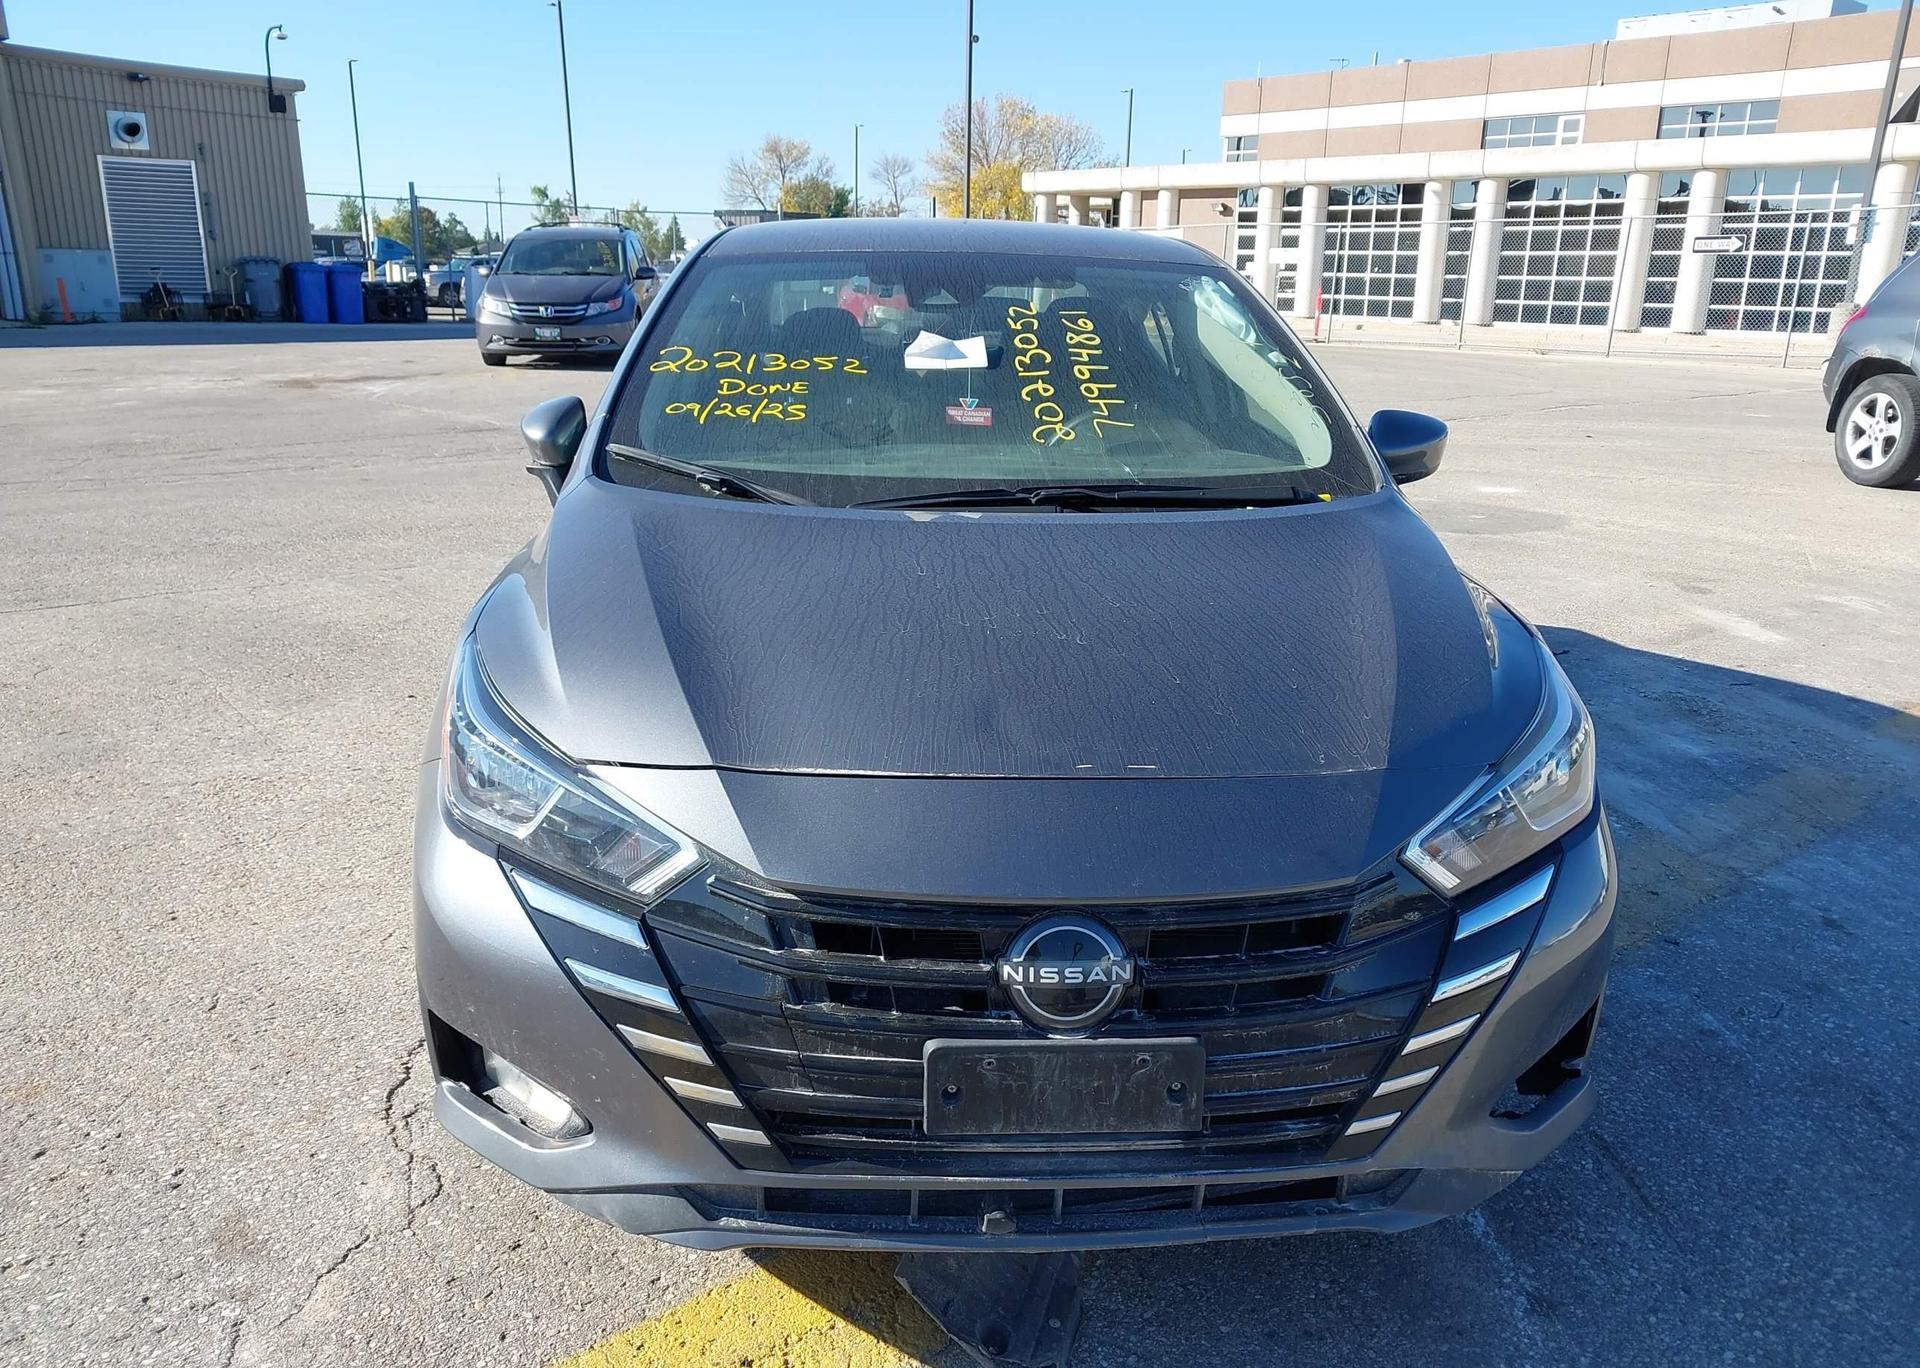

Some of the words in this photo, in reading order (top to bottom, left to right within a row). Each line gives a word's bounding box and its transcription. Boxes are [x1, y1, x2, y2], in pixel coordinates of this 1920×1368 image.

[1696, 240, 1713, 249] ONE
[1718, 240, 1736, 249] WAY
[649, 346, 868, 374] 20213052
[1006, 301, 1077, 444] 20213052
[717, 378, 809, 395] DONE
[665, 398, 807, 424] 09/26/25
[1003, 963, 1132, 984] NISSAN
